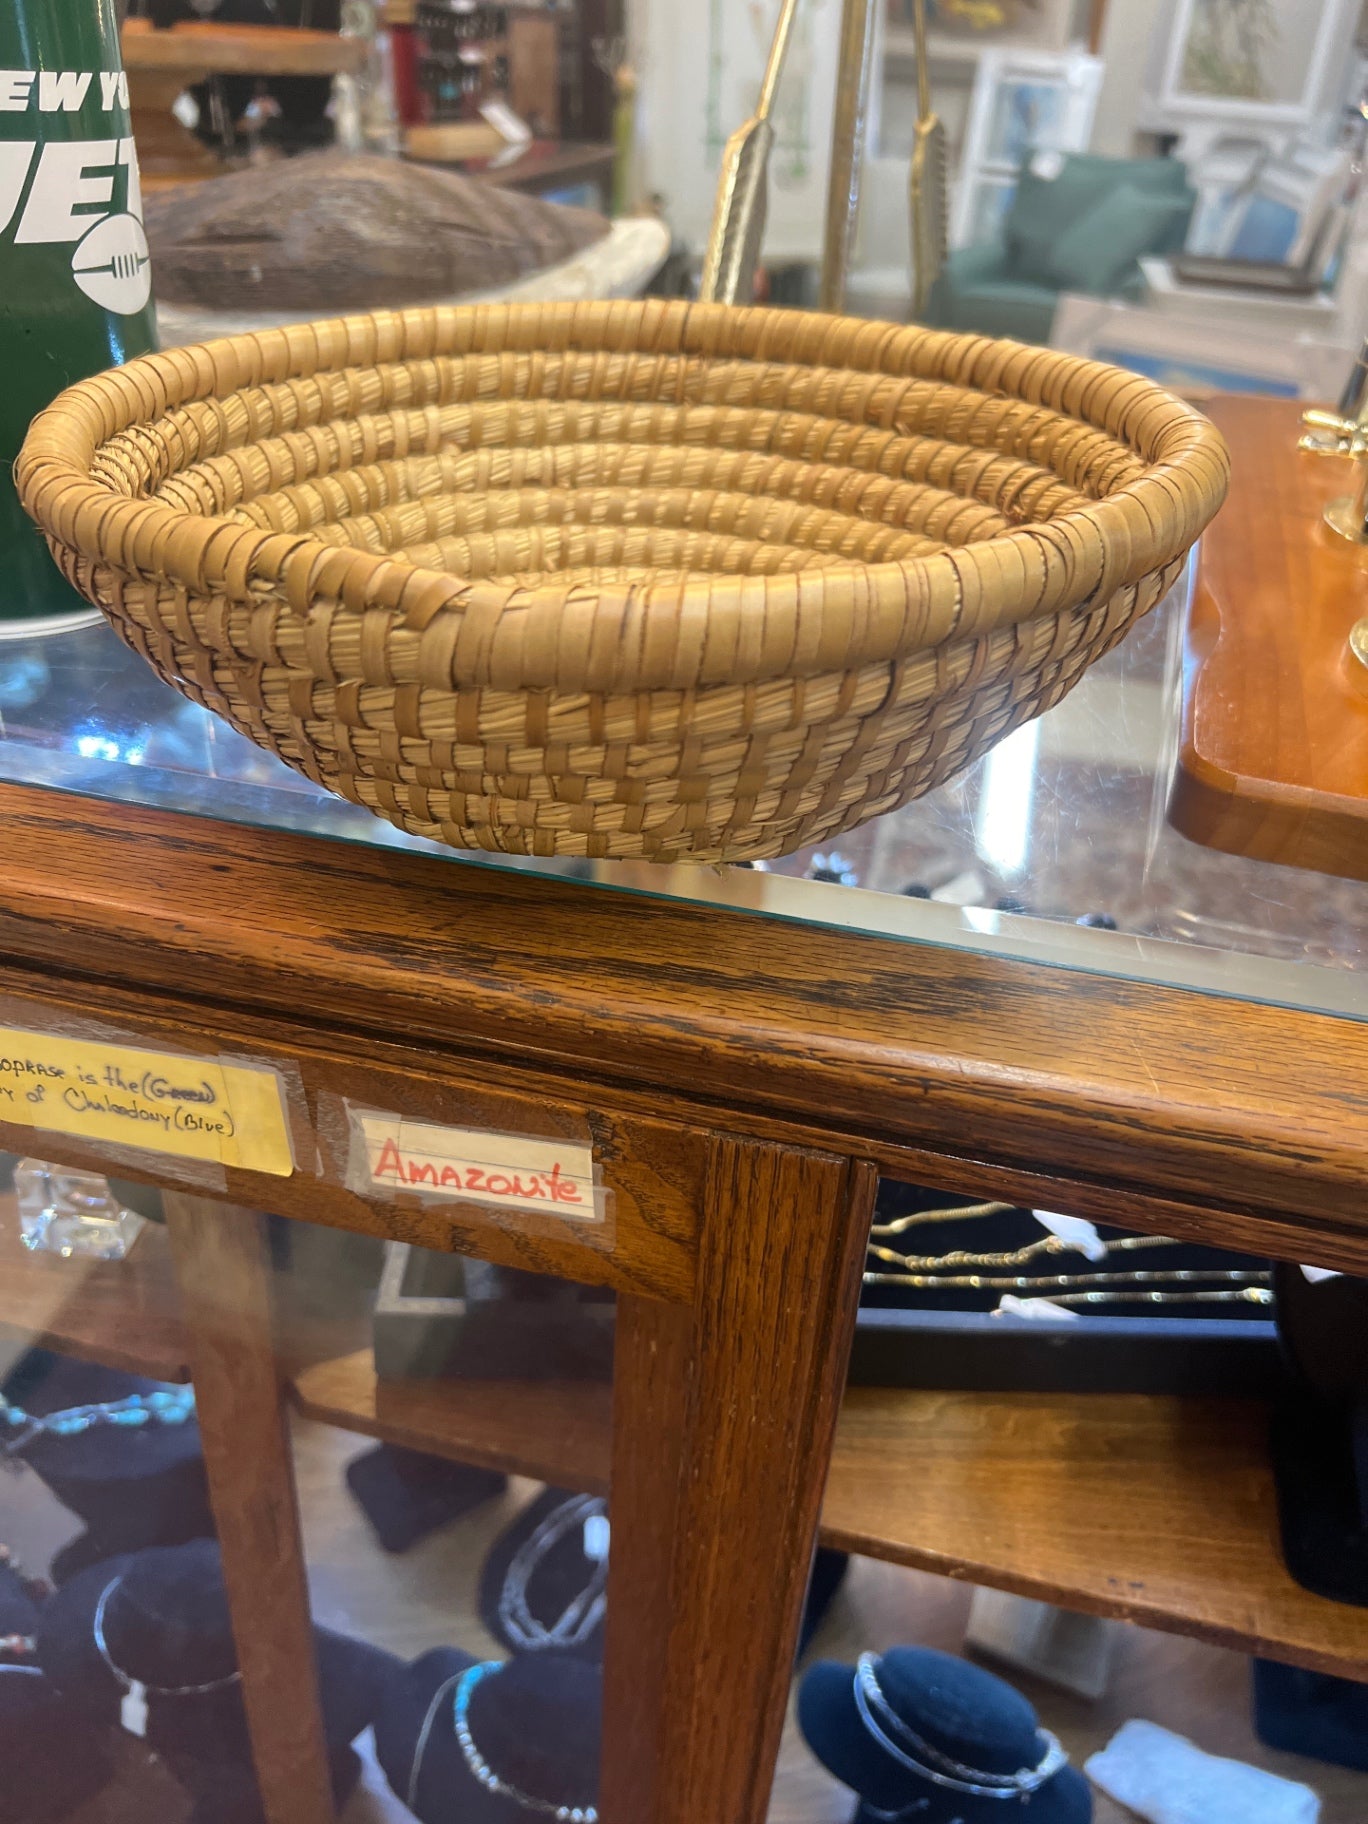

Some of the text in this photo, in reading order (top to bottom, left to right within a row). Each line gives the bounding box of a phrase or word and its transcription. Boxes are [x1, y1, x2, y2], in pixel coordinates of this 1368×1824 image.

[77, 1065, 98, 1085] is
[103, 1065, 139, 1094] the
[26, 1083, 45, 1102] of
